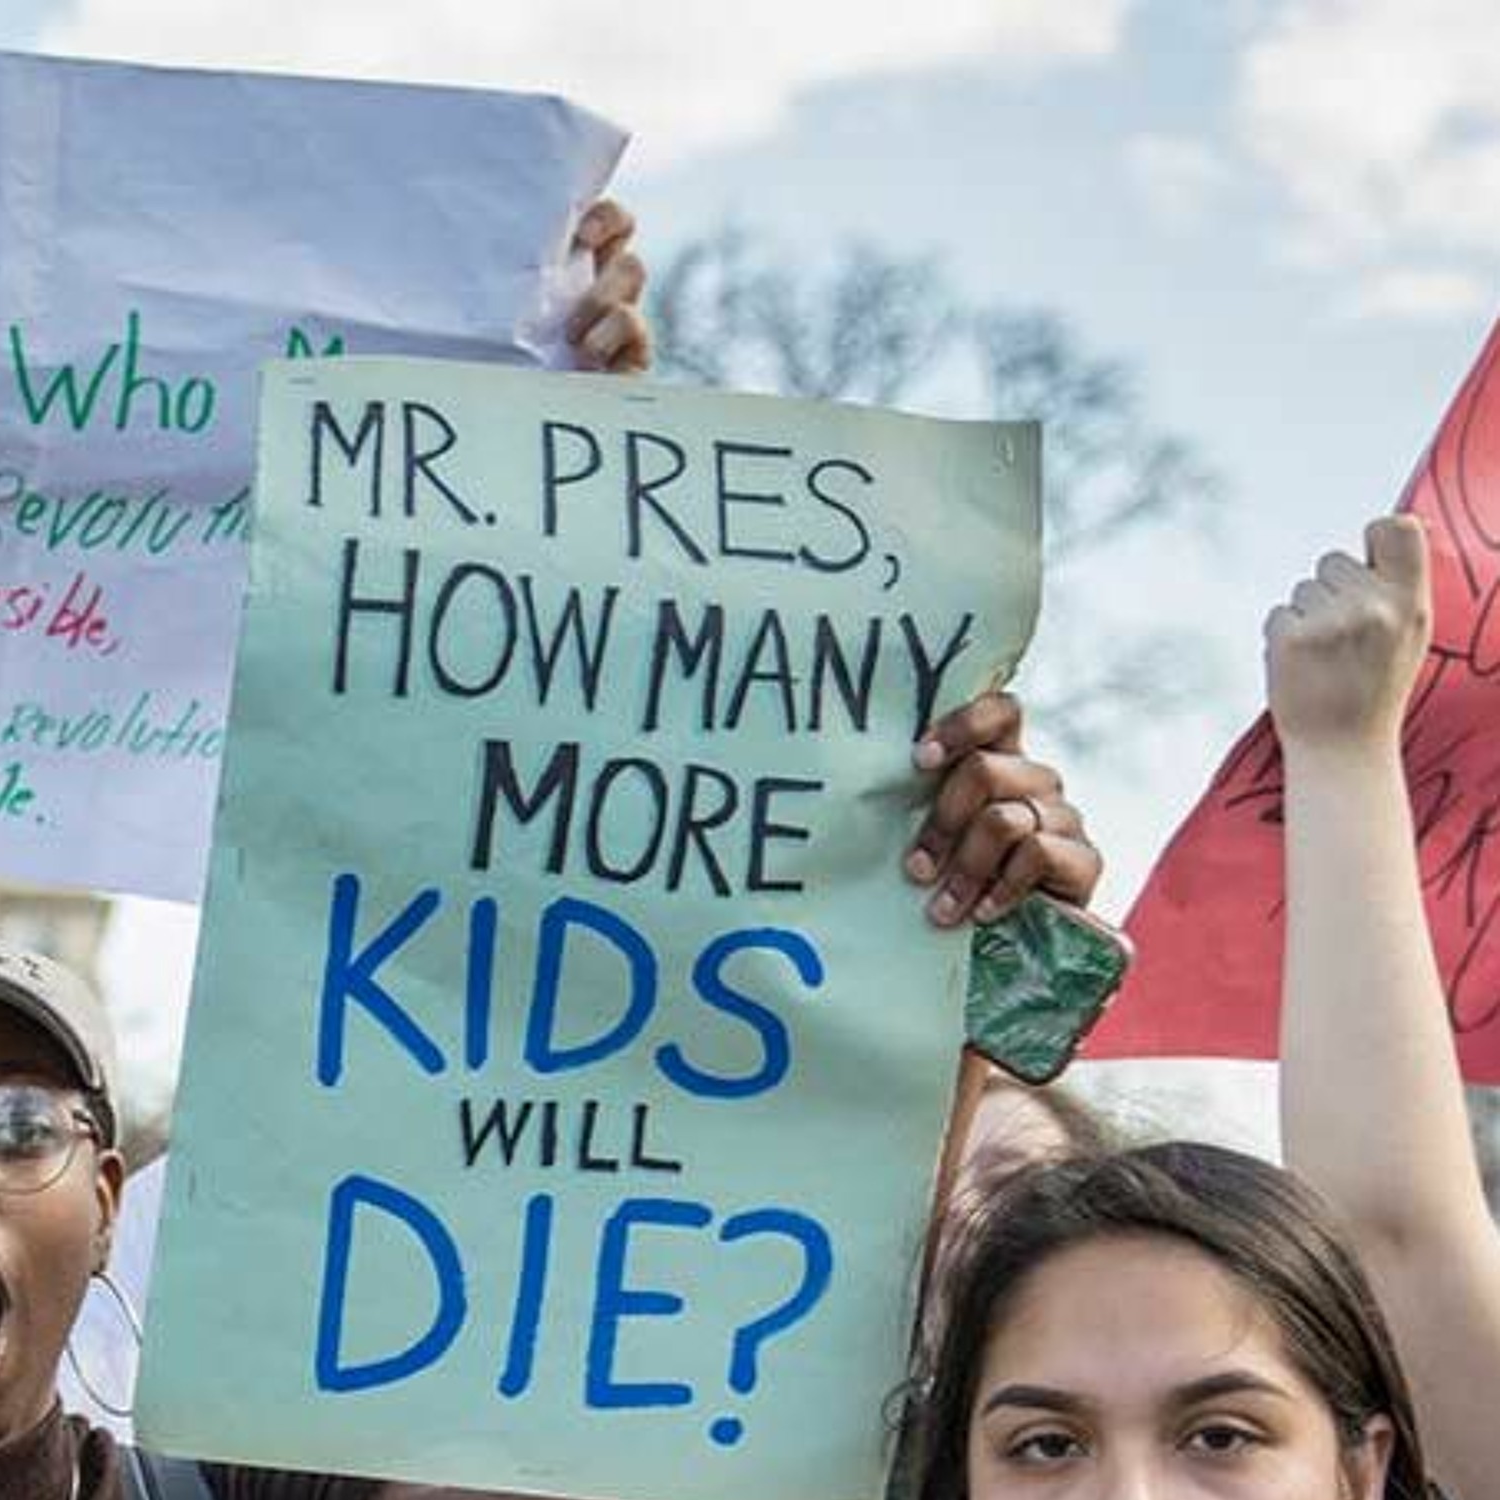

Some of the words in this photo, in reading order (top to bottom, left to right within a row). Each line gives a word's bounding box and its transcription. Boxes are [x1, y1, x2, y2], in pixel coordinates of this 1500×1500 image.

[9, 311, 215, 434] Who
[306, 400, 498, 528] MR.
[541, 419, 904, 588] PRES,
[1, 690, 224, 758] Revolutio
[330, 538, 619, 711] HOW
[642, 599, 975, 742] MANY
[470, 738, 825, 898] MORE
[315, 871, 826, 1100] KIDS
[459, 1097, 683, 1173] WILL
[314, 1172, 835, 1446] DIE?
